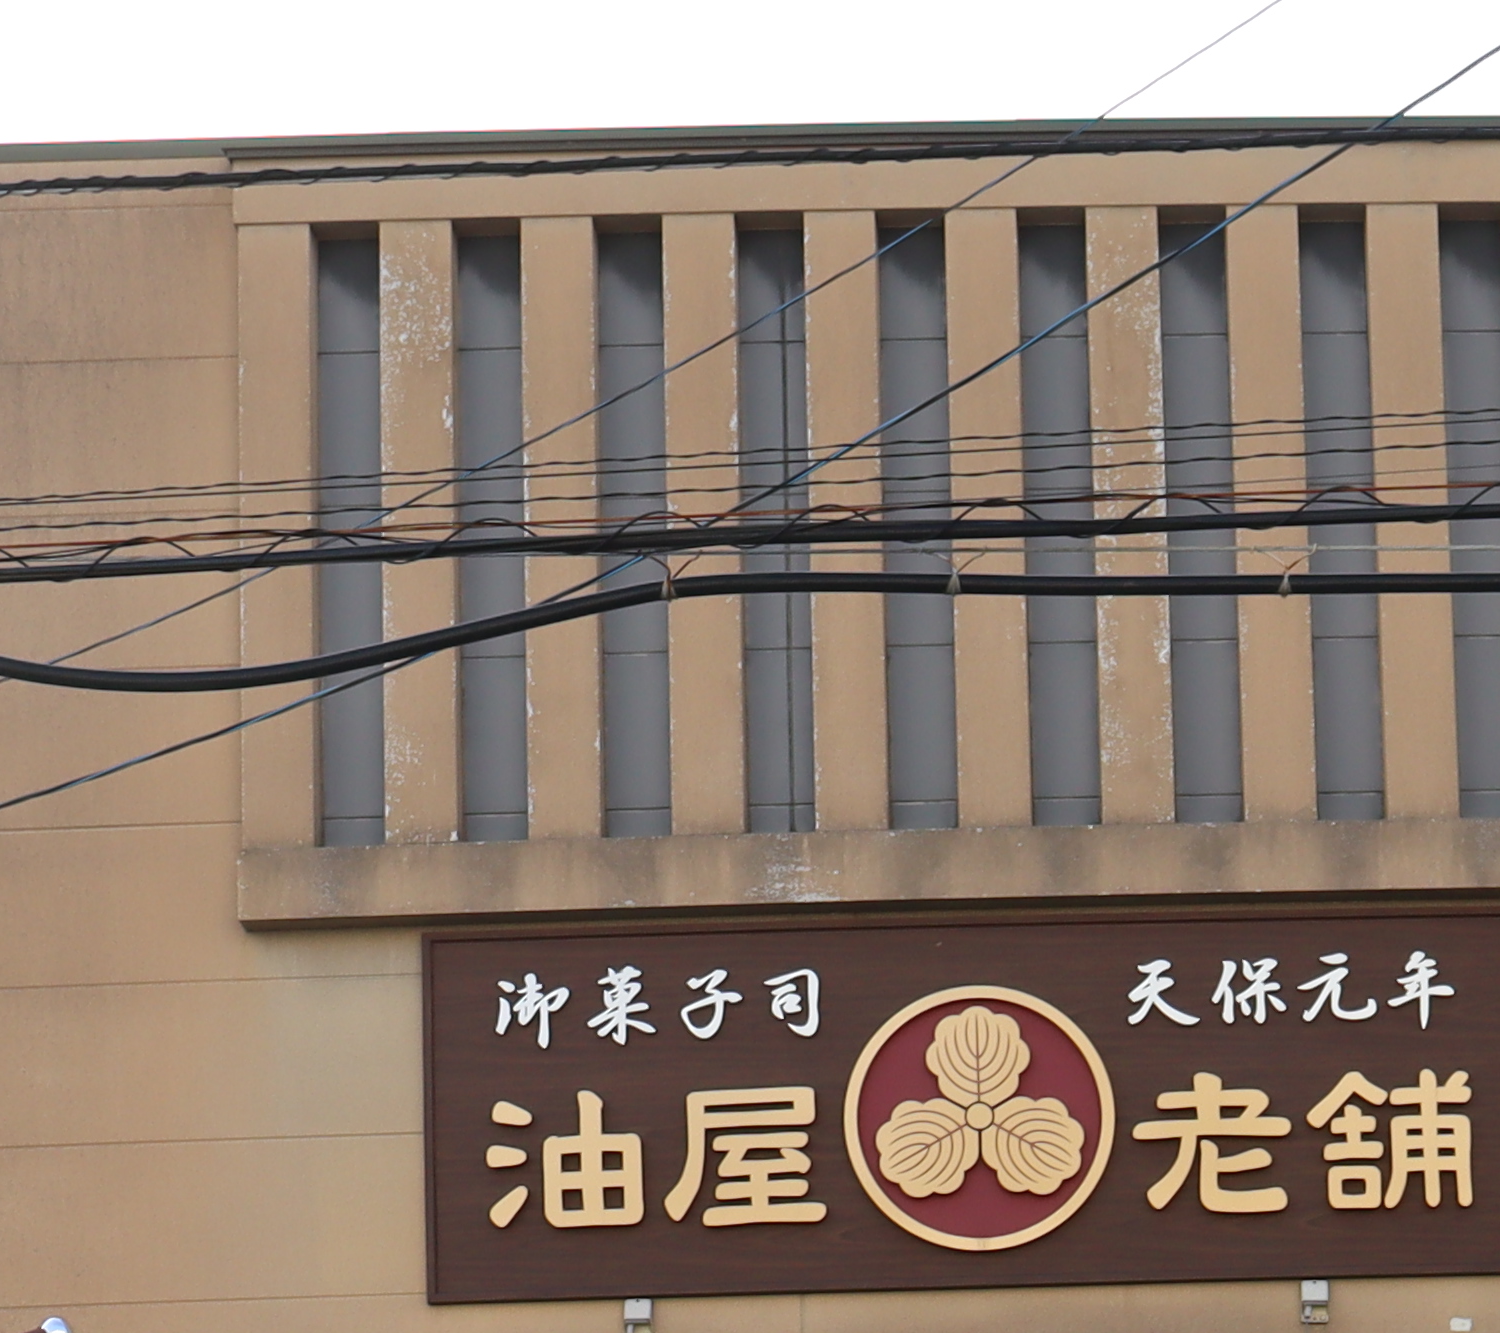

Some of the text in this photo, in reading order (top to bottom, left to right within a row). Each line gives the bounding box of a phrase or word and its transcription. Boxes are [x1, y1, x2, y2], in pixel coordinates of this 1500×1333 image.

[493, 966, 821, 1049] 御菓子司
[1126, 950, 1455, 1030] 天保元年
[485, 1068, 1475, 1228] 油屋 老舗
